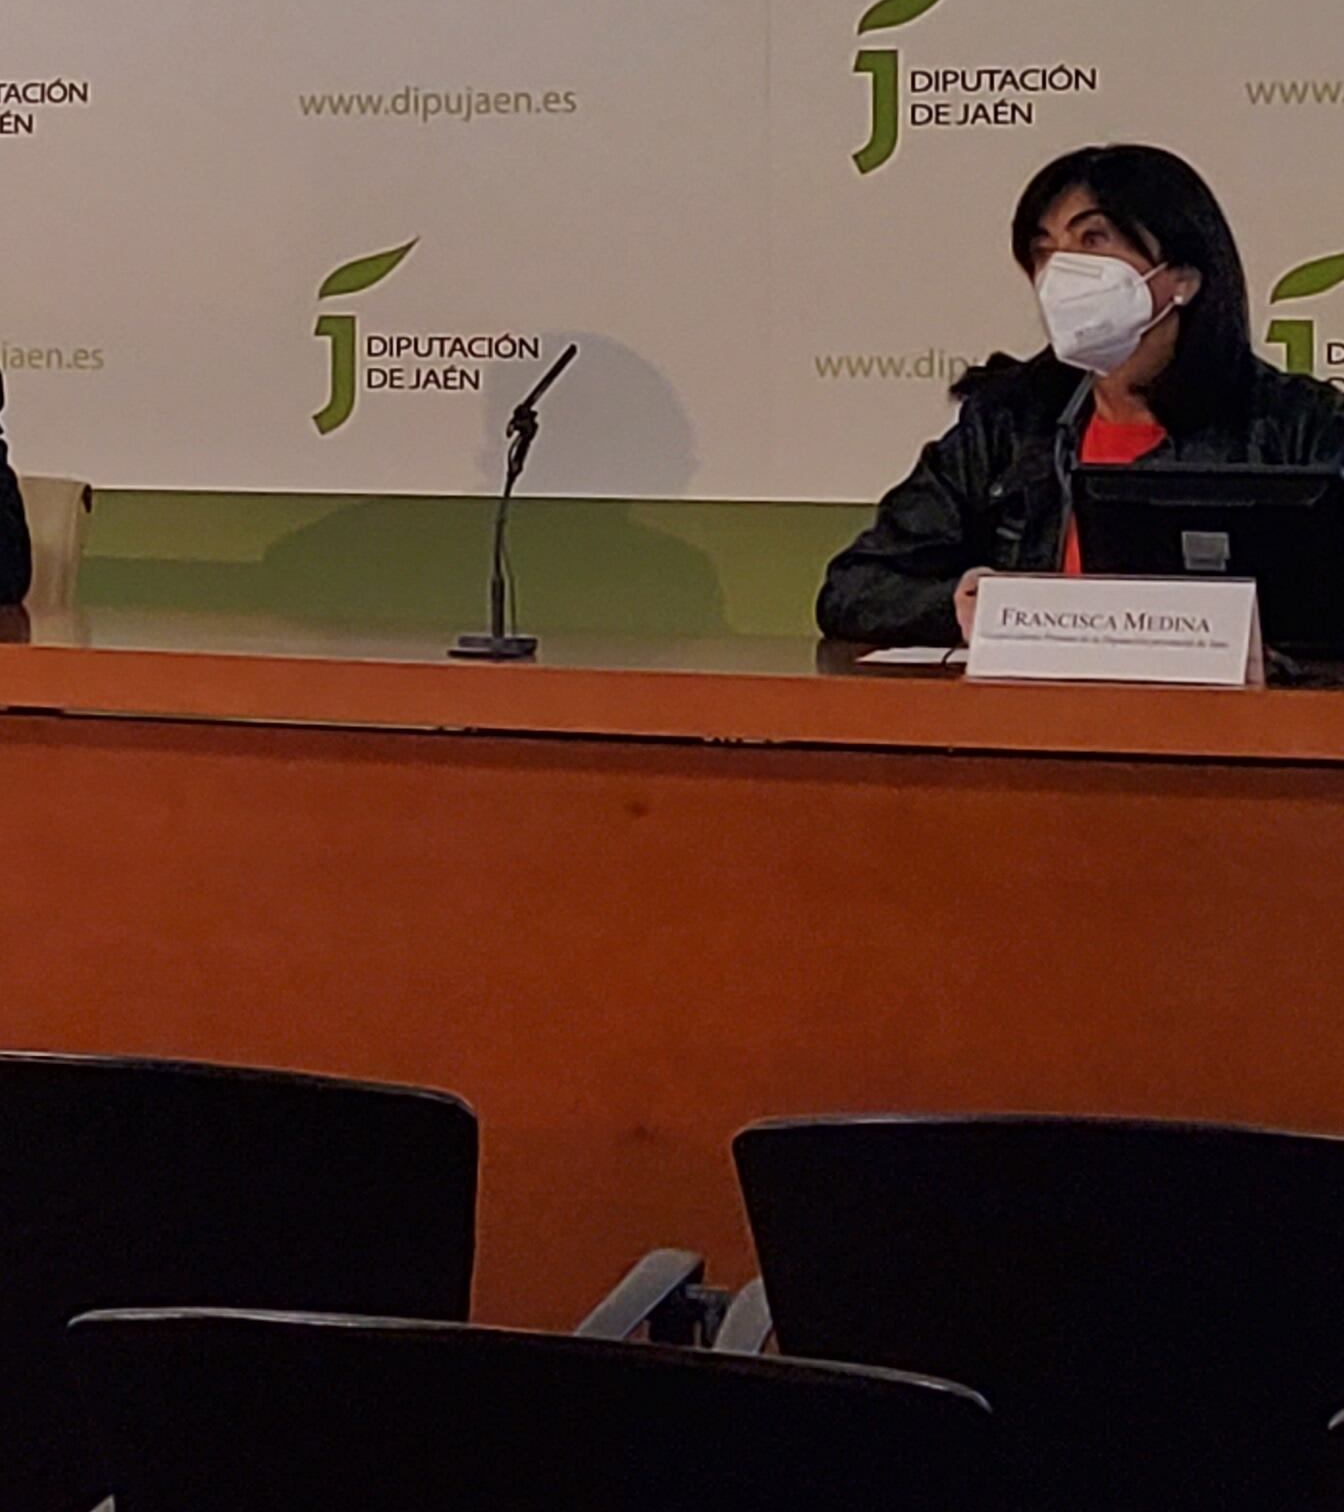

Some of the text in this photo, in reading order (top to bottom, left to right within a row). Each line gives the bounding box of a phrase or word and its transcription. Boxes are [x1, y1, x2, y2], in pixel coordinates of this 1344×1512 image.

[909, 64, 1098, 94] DIPUTACIÓN
[298, 85, 578, 124] www.dipujaen.es
[909, 98, 1034, 126] DE JAÉN
[366, 333, 540, 359] DIPUTACIÓN
[366, 364, 481, 391] DE JAÉN
[814, 347, 978, 387] www.dip
[1002, 607, 1211, 634] FRANCISCA MEDINA
